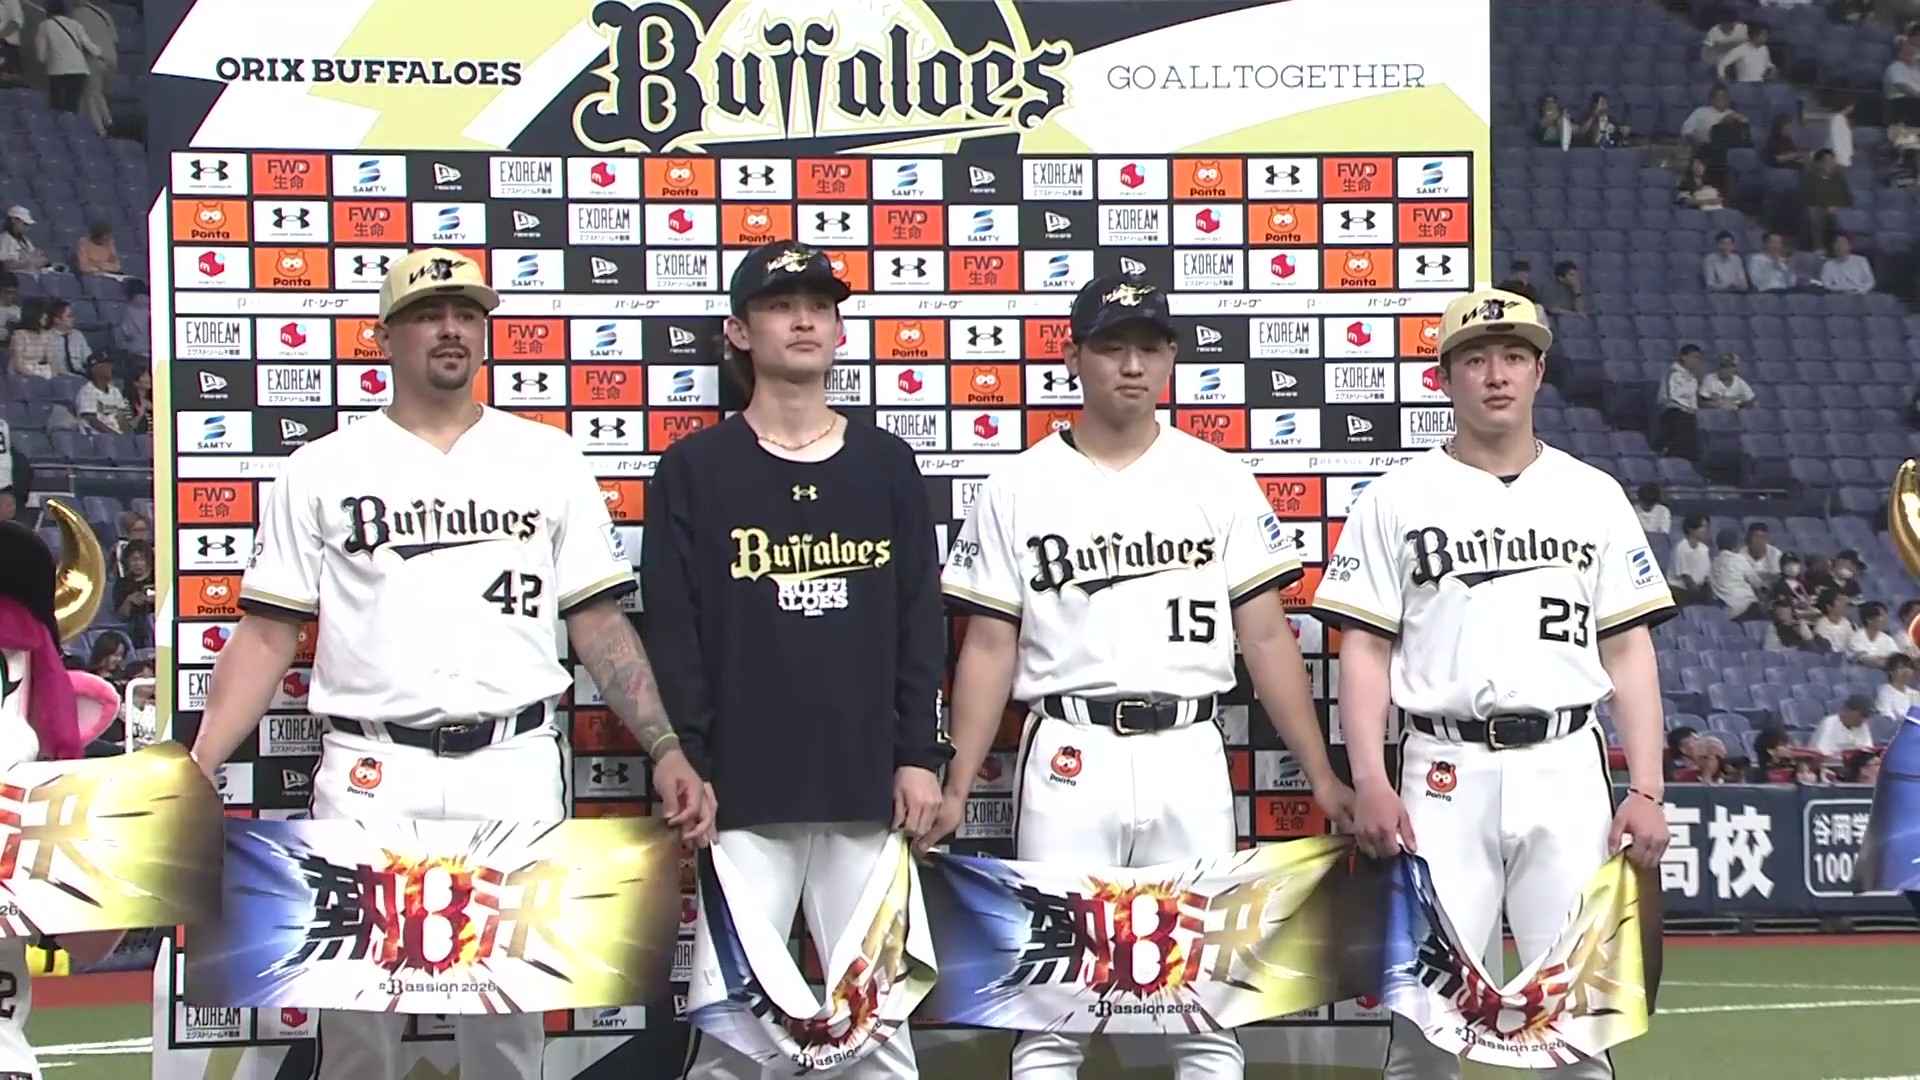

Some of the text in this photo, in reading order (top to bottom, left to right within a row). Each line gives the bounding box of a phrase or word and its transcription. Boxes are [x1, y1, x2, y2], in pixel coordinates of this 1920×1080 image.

[215, 57, 522, 87] ORIX BUFFALOES
[576, 0, 1070, 152] Buffaloes
[267, 159, 310, 175] FWD
[500, 161, 553, 183] EXDREAM
[811, 164, 852, 179] FWD
[1032, 163, 1083, 185] EXDREAM
[1337, 162, 1378, 178] FWD
[273, 174, 305, 191] 生命
[352, 185, 387, 194] SAMTY
[816, 179, 845, 194] 生命
[1343, 177, 1372, 193] 生命
[1416, 186, 1450, 195] SAMTY
[662, 187, 699, 198] Ponta
[891, 189, 924, 197] SAMTY
[1190, 186, 1226, 197] Ponta
[349, 206, 391, 222] FWD
[579, 207, 630, 230] EXDREAM
[887, 209, 928, 225] FWD
[1108, 208, 1159, 231] EXDREAM
[1412, 207, 1453, 223] FWD
[191, 228, 230, 240] Ponta
[354, 222, 385, 238] 生命
[432, 232, 466, 241] SAMTY
[738, 232, 776, 243] Ponta
[892, 224, 922, 240] 生命
[1265, 231, 1301, 243] Ponta
[1418, 223, 1447, 238] 生命
[967, 235, 999, 243] SAMTY
[656, 253, 707, 276] EXDREAM
[963, 255, 1004, 271] FWD
[1183, 252, 1234, 275] EXDREAM
[273, 276, 311, 287] Ponta
[511, 279, 545, 288] SAMTY
[968, 270, 997, 286] 生命
[1043, 280, 1075, 288] SAMTY
[1341, 276, 1377, 287] Ponta
[186, 321, 240, 344] EXDREAM
[507, 323, 549, 339] FWD
[1259, 321, 1309, 344] EXDREAM
[513, 339, 543, 354] 生命
[590, 349, 623, 357] SAMTY
[891, 347, 928, 358] Ponta
[1417, 346, 1440, 355] Pon
[267, 368, 321, 391] EXDREAM
[585, 369, 627, 386] FWD
[824, 367, 861, 390] DREAM
[1334, 366, 1385, 389] EXDREAM
[591, 385, 621, 401] 生命
[667, 395, 701, 403] SAMTY
[967, 392, 1004, 403] Ponta
[1194, 393, 1226, 401] SAMTY
[662, 415, 704, 431] FWD
[1190, 414, 1231, 430] FWD
[197, 441, 232, 450] SAMTY
[1269, 438, 1301, 446] SAMTY
[193, 487, 236, 502] FWD
[1266, 482, 1306, 497] FWD
[198, 502, 230, 518] 生命
[341, 495, 541, 554] Buffaloes
[729, 527, 891, 582] Buffaloes
[1026, 530, 1215, 593] Buffaloes
[1406, 525, 1597, 587] Buffaloes
[481, 569, 544, 618] 42
[1280, 597, 1306, 606] onta
[197, 604, 236, 615] Ponta
[1166, 597, 1218, 643] 15
[1538, 596, 1590, 648] 23
[1273, 779, 1306, 788] SAMTY
[1269, 802, 1311, 816] FWD
[1275, 816, 1304, 831] 生命
[1812, 813, 1871, 846] 谷岡学
[1661, 802, 1775, 900] 高校
[592, 1019, 627, 1028] SAMTY
